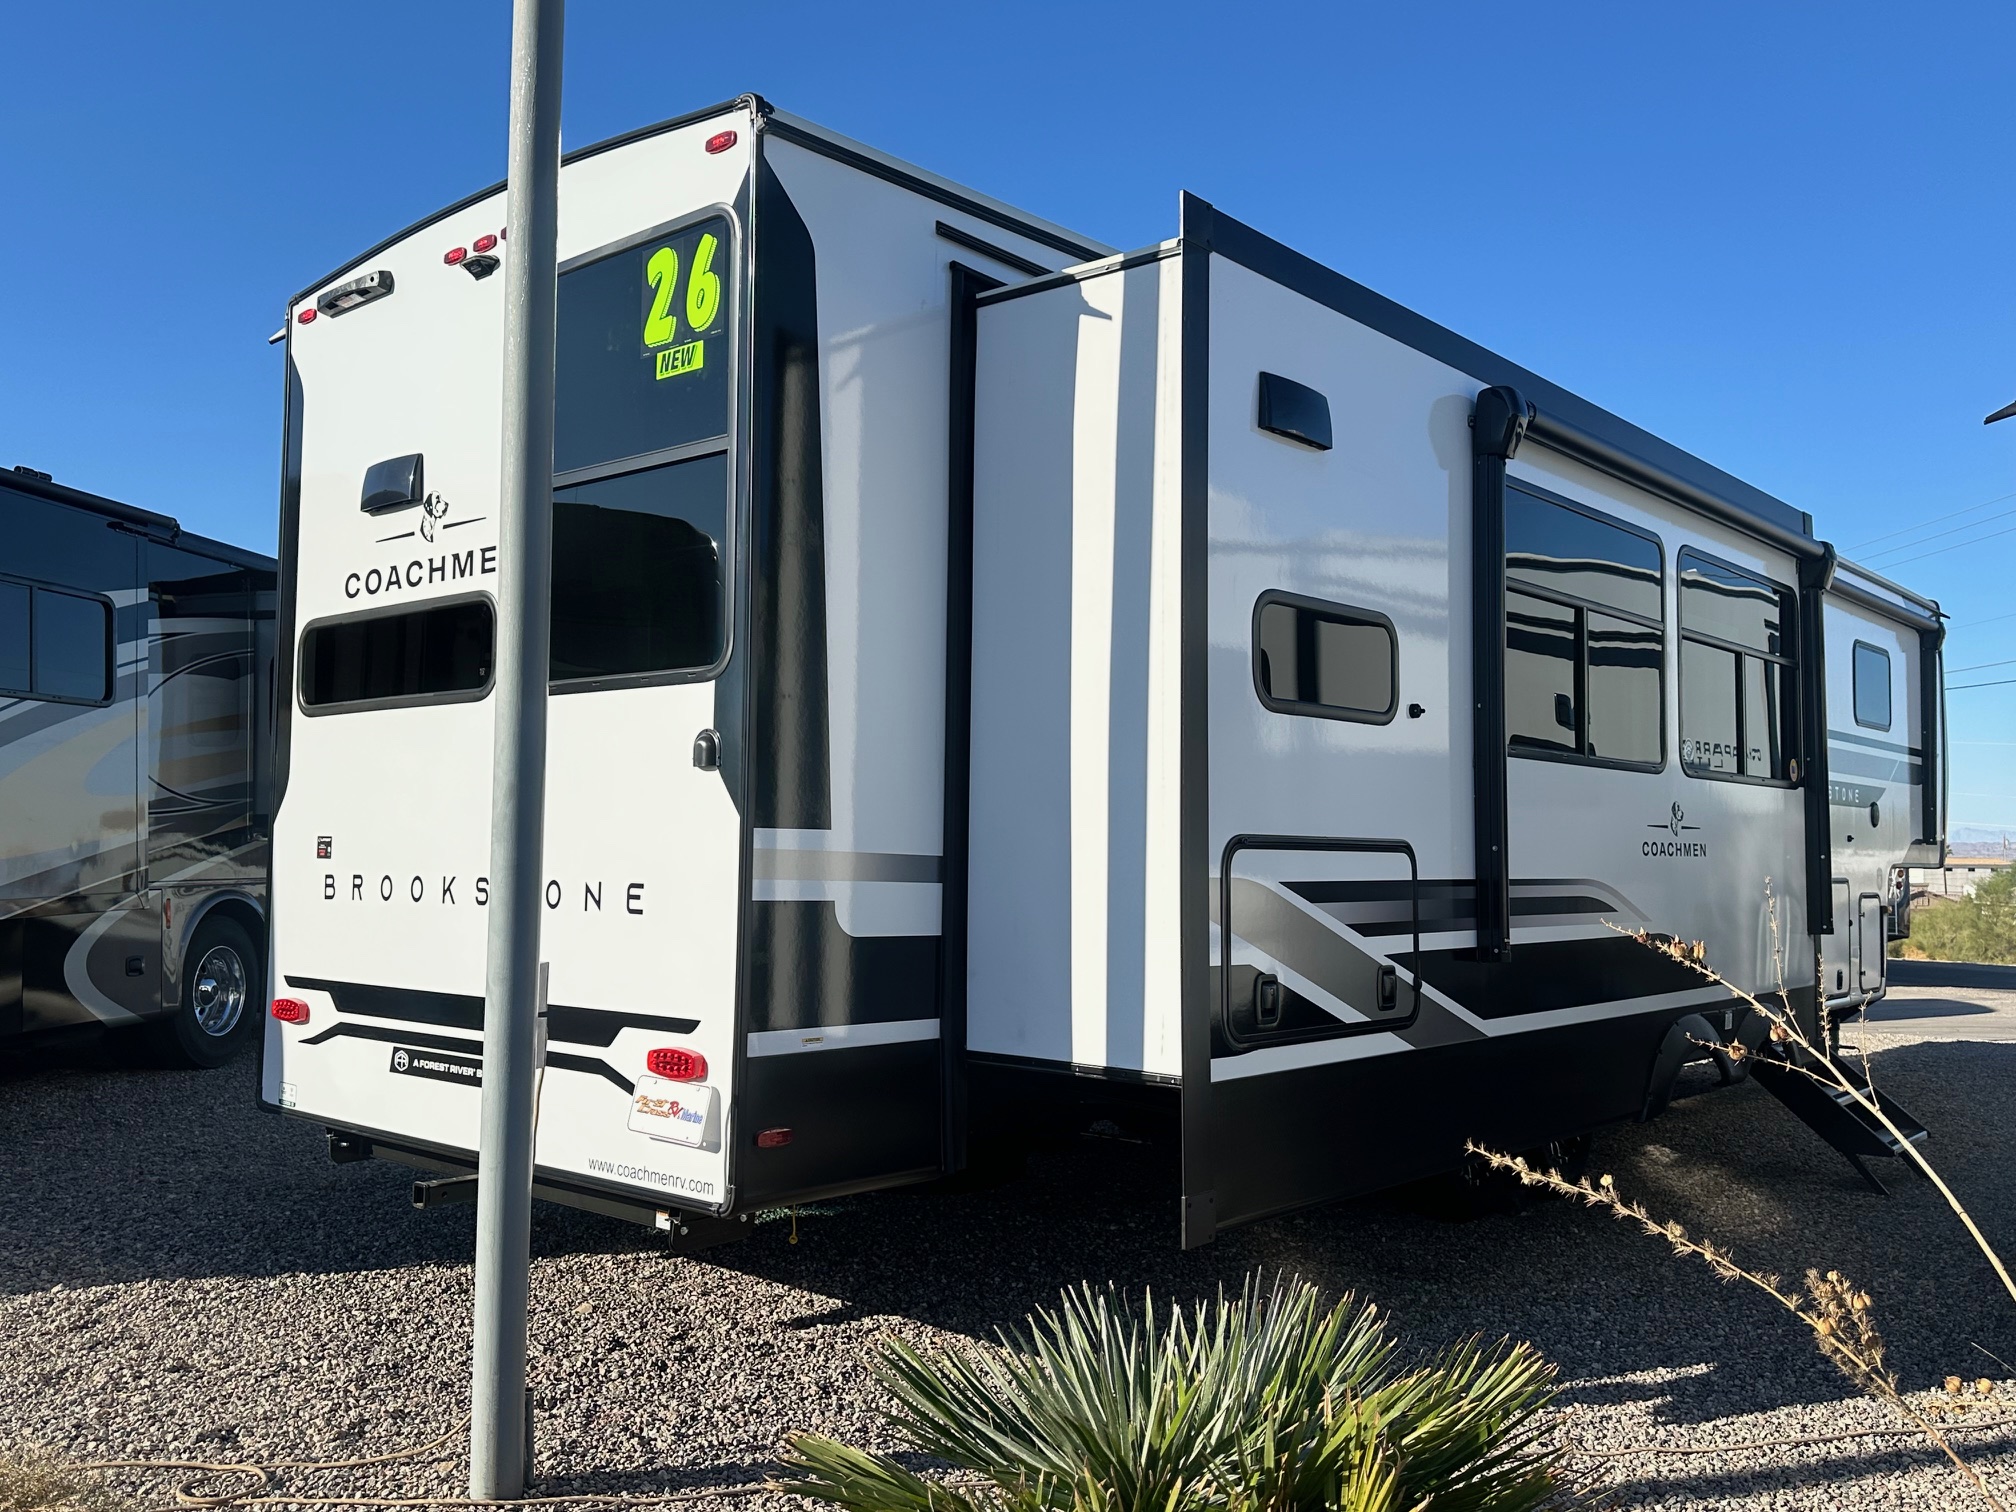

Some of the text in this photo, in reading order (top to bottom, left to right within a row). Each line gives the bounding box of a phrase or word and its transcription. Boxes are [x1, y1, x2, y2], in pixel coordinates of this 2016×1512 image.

[644, 233, 720, 347] 26
[660, 344, 698, 376] NEW
[344, 545, 497, 599] COACHME
[1828, 785, 1860, 803] STONE
[1642, 841, 1707, 857] COACHMEN
[324, 874, 645, 915] BROOKSONE
[412, 1059, 419, 1068] A
[419, 1060, 450, 1072] FOREST
[681, 1108, 703, 1125] Marine
[588, 1158, 714, 1196] www.coachmenrv.com
